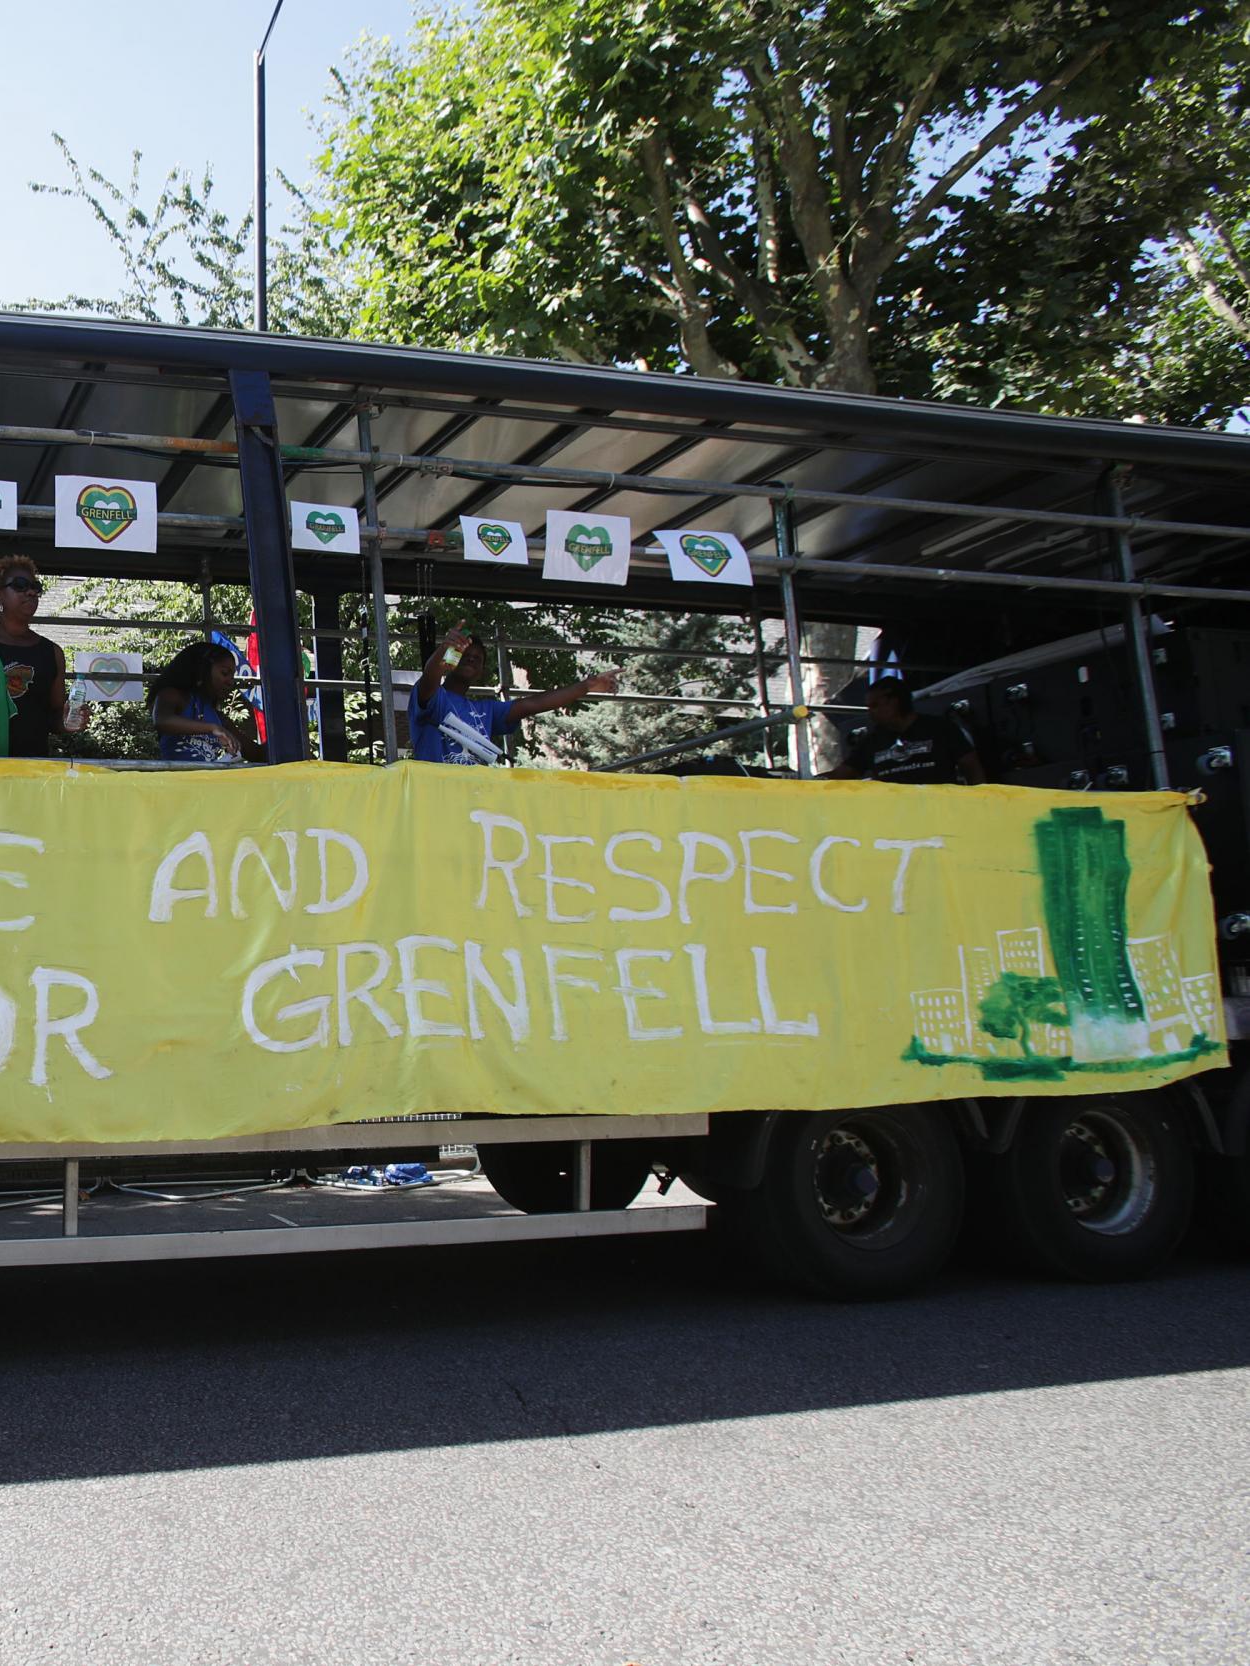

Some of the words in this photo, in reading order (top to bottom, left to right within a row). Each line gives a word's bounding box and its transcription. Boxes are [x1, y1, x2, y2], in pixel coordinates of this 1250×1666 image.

[81, 506, 134, 520] GRENFELL
[568, 543, 610, 555] GRENFELL
[148, 829, 372, 922] AND
[469, 808, 945, 925] RESPECT
[242, 933, 819, 1053] GRENFELL
